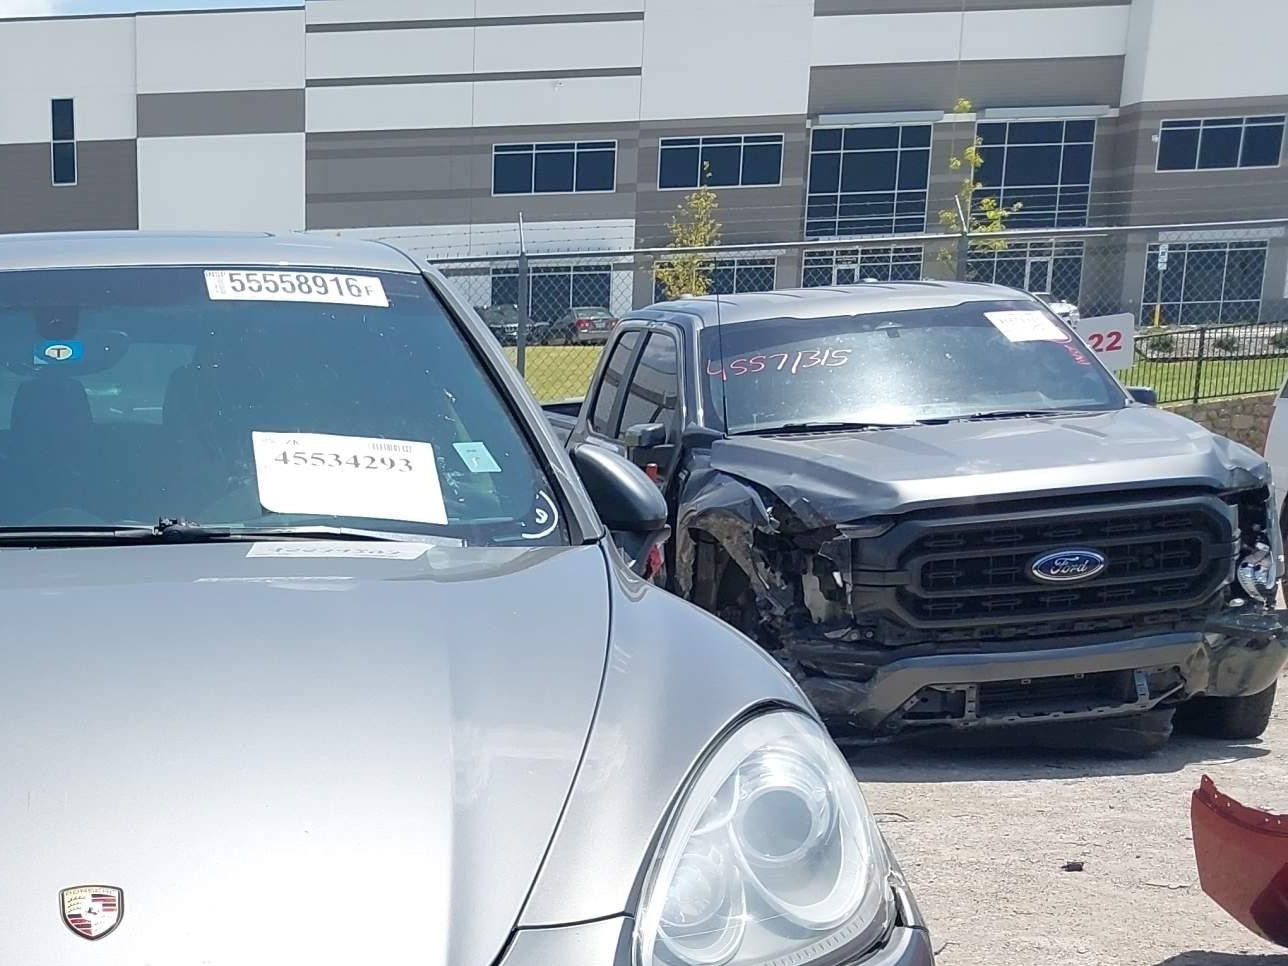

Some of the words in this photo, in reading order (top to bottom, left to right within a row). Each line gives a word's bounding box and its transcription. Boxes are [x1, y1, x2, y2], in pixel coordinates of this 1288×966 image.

[228, 272, 363, 298] 55558916
[1088, 331, 1123, 353] 22
[273, 450, 414, 473] 45534293
[1050, 556, 1089, 575] Ford
